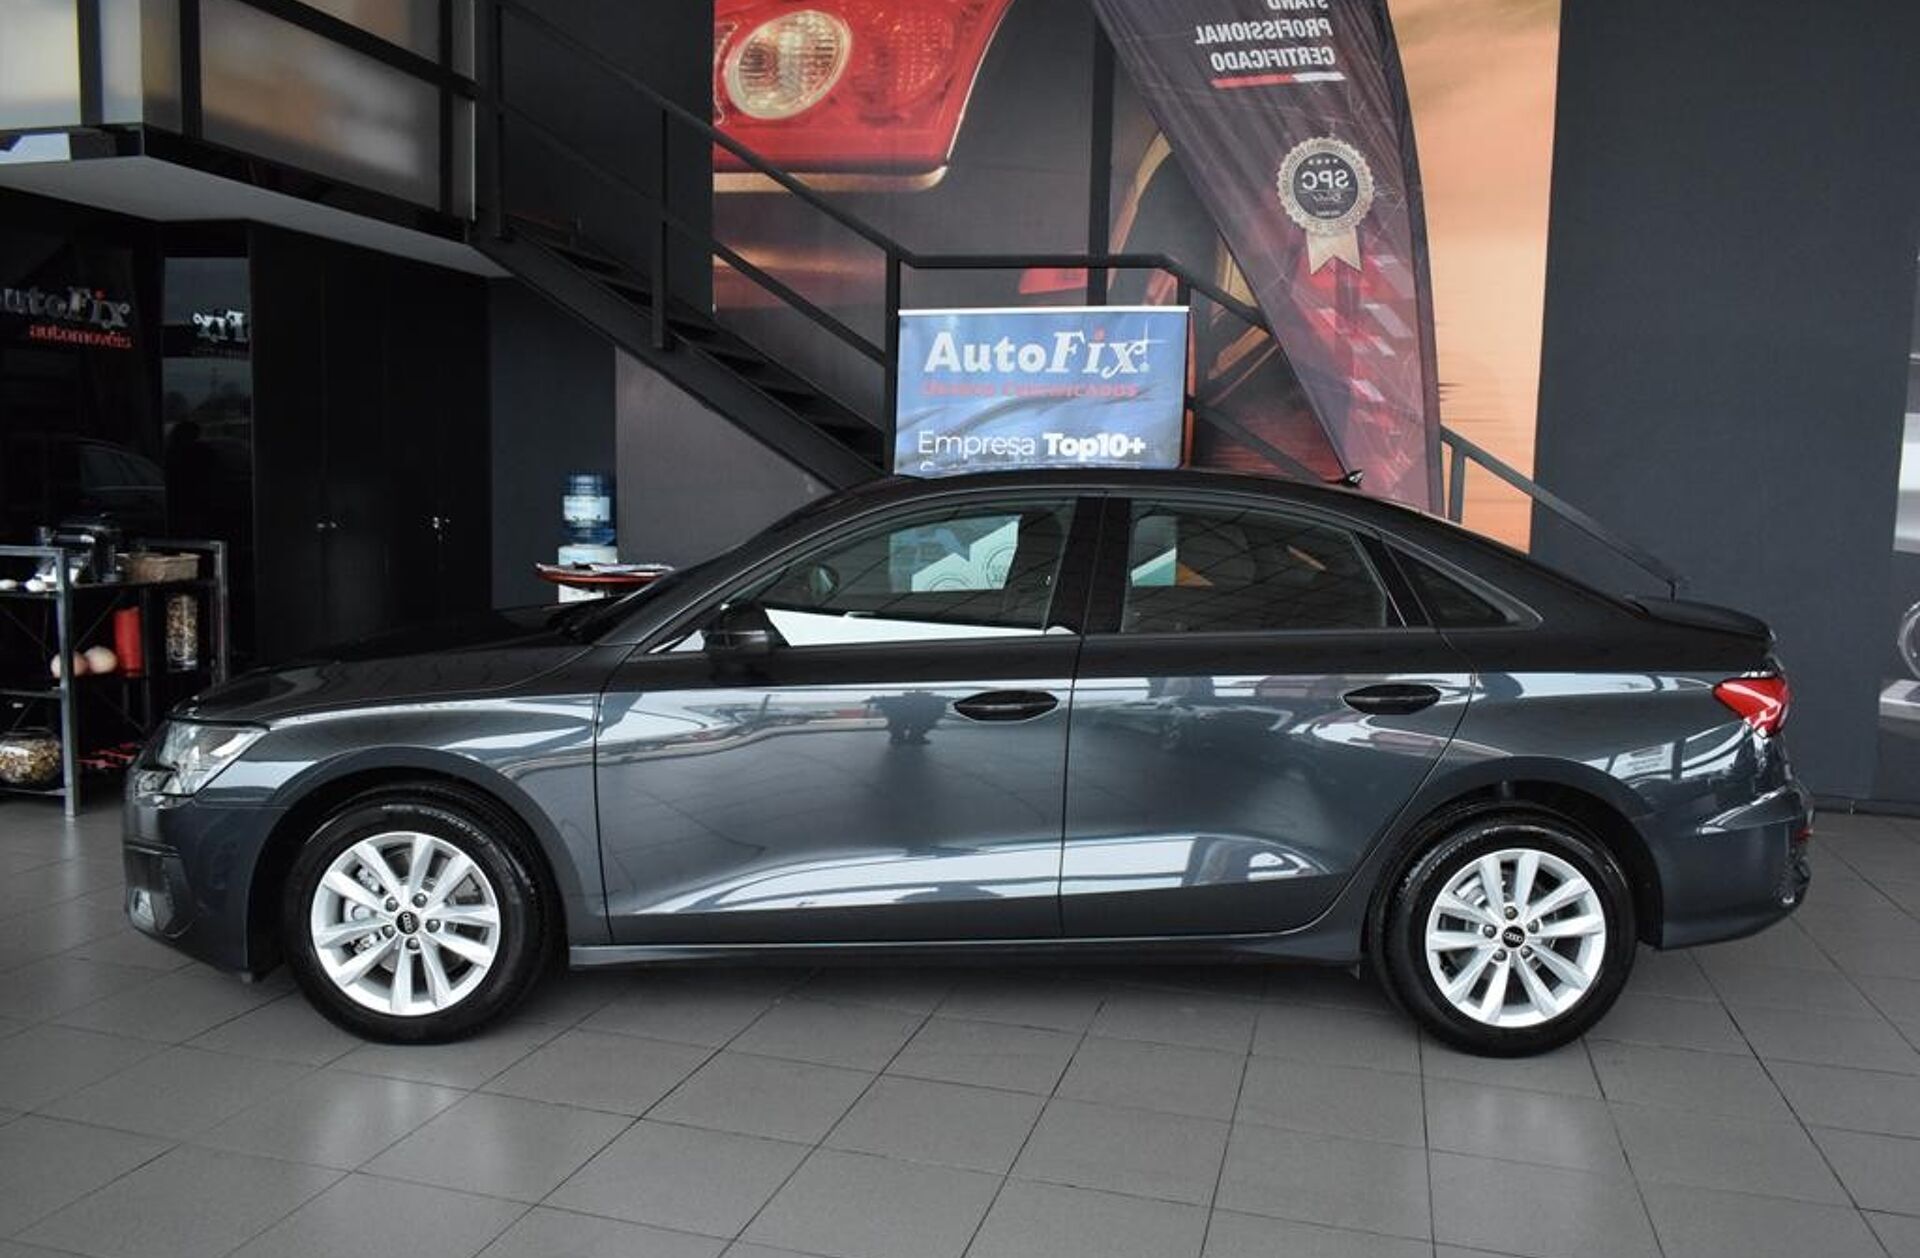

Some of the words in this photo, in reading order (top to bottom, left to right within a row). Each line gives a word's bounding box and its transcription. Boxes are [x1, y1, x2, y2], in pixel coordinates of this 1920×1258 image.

[0, 286, 131, 328] utoFix
[918, 430, 1036, 458] Empresa
[1042, 432, 1147, 461] Top10+
